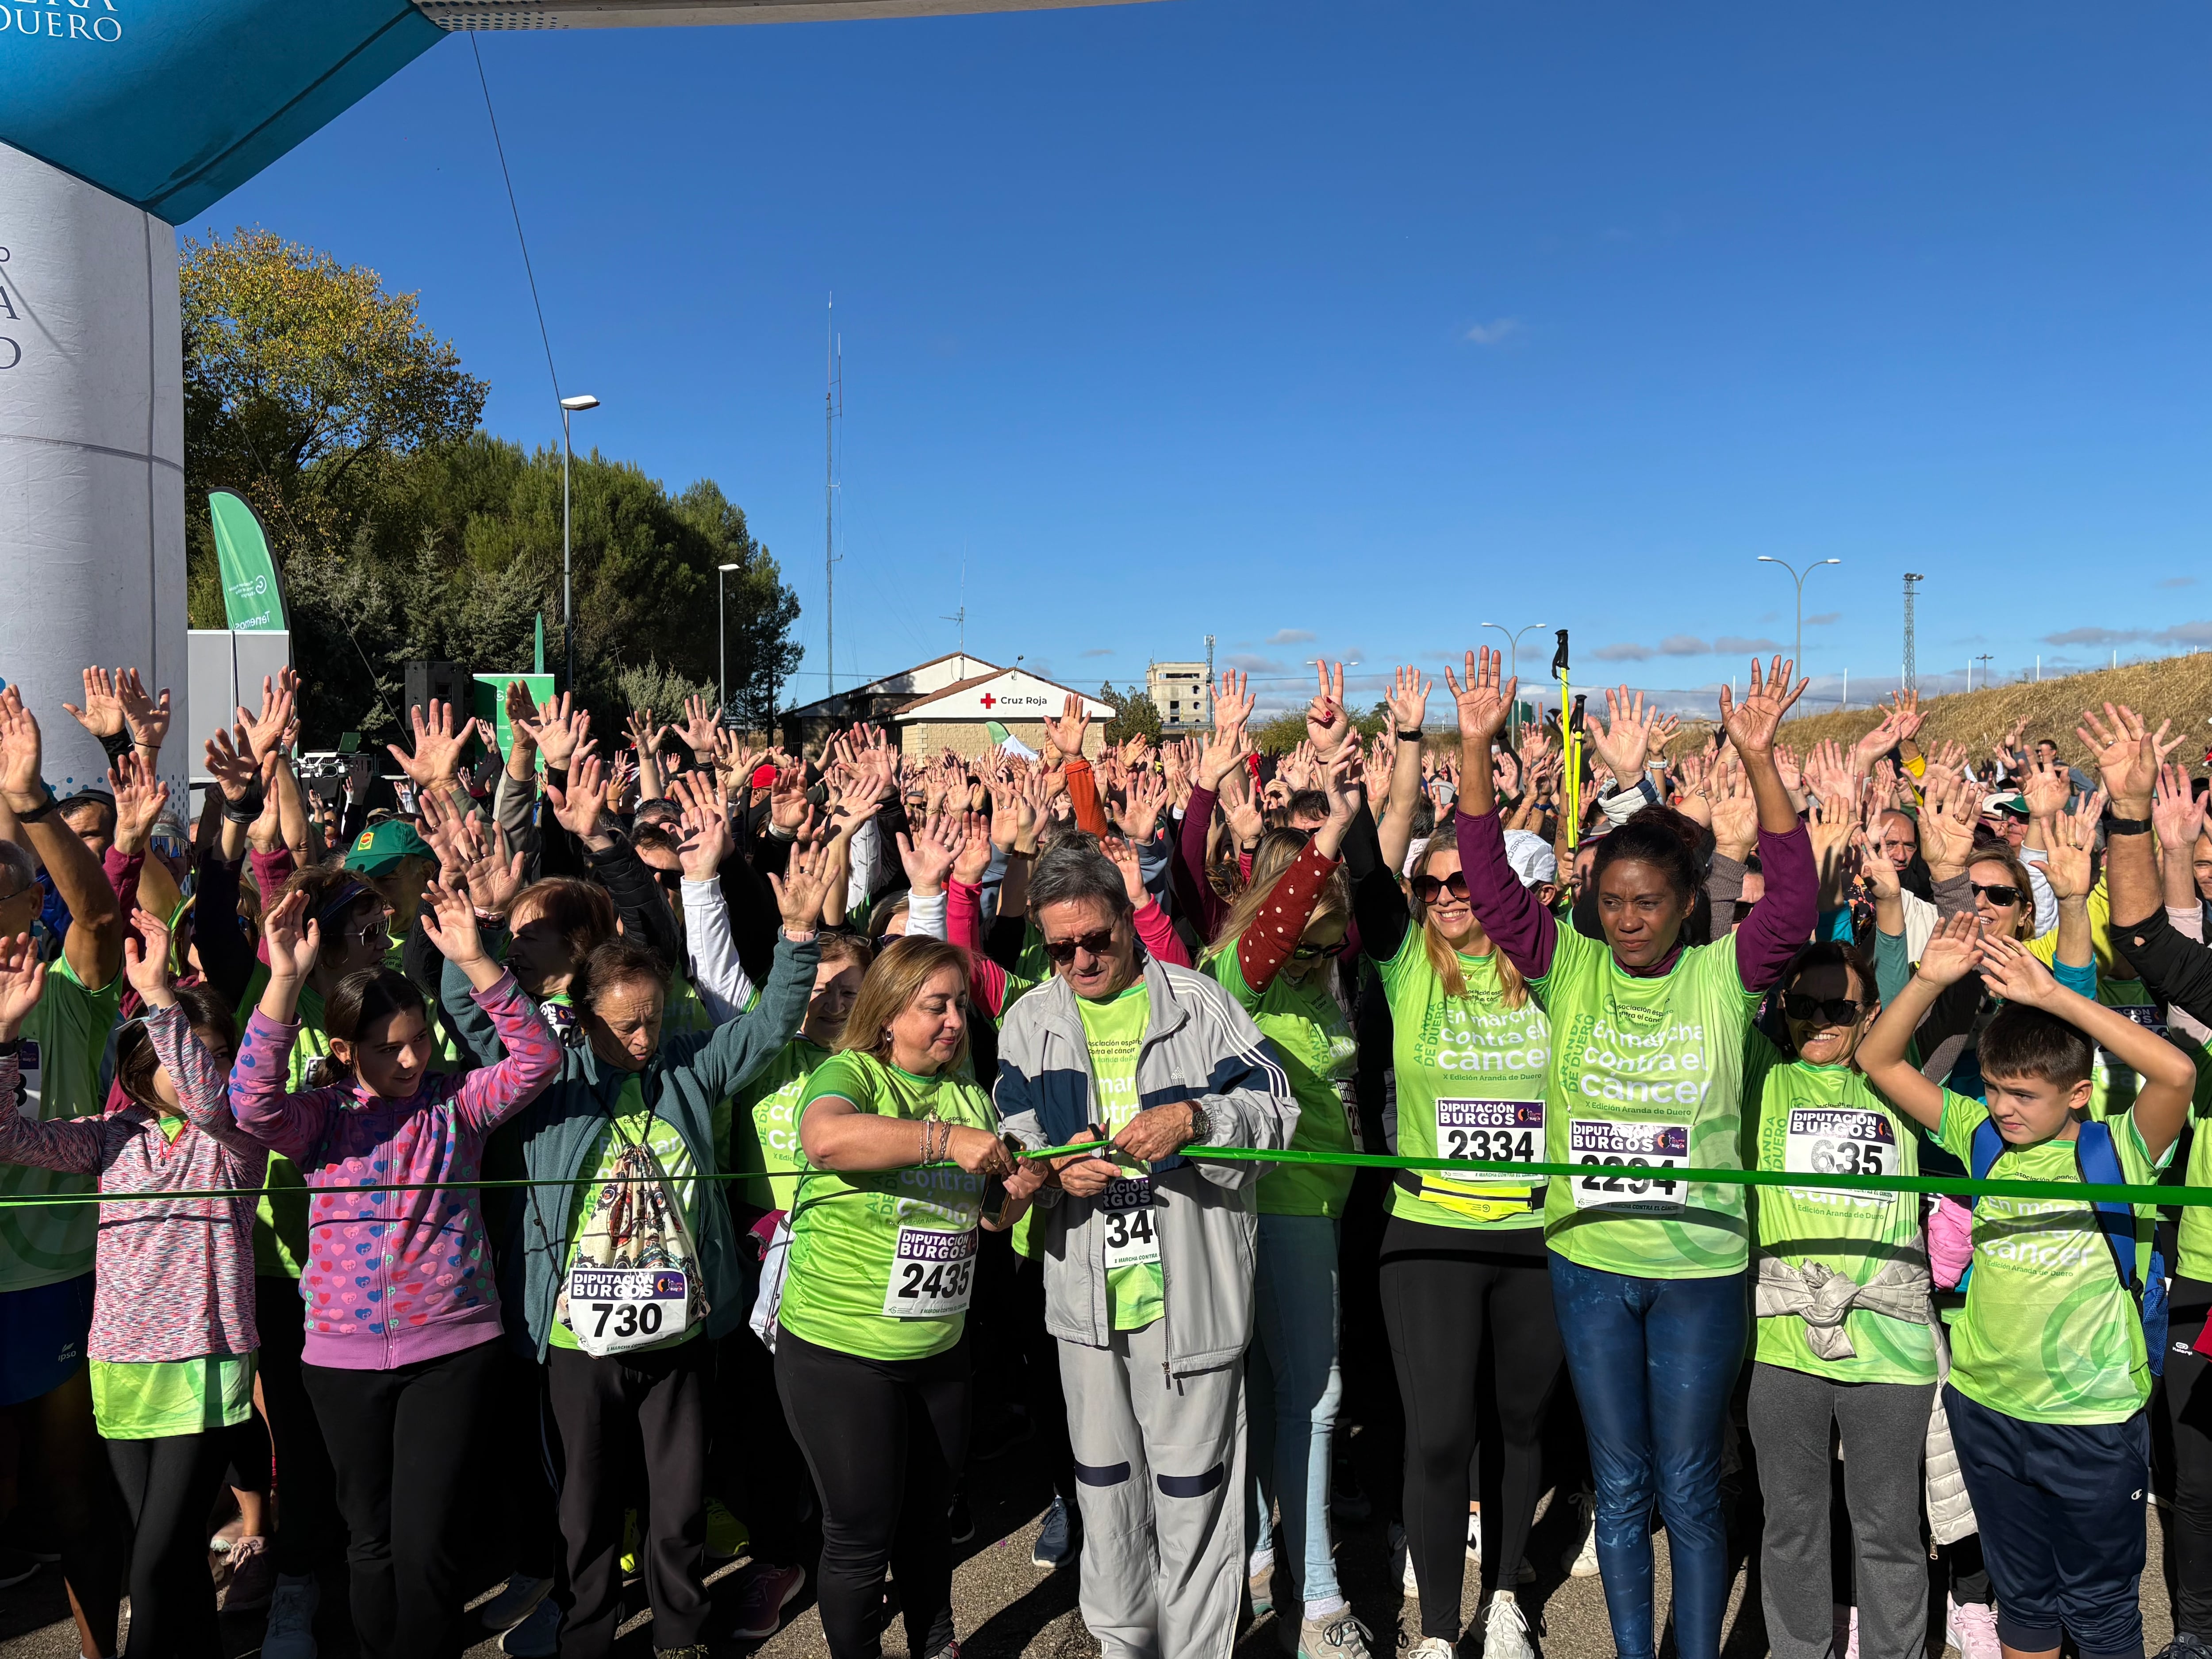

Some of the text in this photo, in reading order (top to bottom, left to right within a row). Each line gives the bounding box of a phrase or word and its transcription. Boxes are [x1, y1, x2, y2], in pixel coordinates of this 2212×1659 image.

[1026, 696, 1047, 706] Roja
[1471, 1002, 1540, 1028] marcha
[1617, 1005, 1651, 1014] sociación
[1413, 1003, 1436, 1065] ARANDA
[1424, 1001, 1444, 1067] DE DUERO
[1440, 1018, 1548, 1047] contra el
[1593, 1019, 1703, 1048] En marcha
[1559, 1013, 1584, 1088] ARANDA
[1568, 1015, 1595, 1093] DE DUERO
[1584, 1046, 1709, 1072] contra el
[1581, 1071, 1712, 1104] cáncer
[1440, 1102, 1514, 1113] DIPUTACIÓN
[1592, 1102, 1620, 1112] Edición
[1622, 1106, 1652, 1114] Aranda
[1440, 1113, 1515, 1125] BURGOS
[1793, 1112, 1877, 1126] DIPUTACIÓN
[759, 1126, 768, 1145] DE
[1573, 1125, 1654, 1139] DIPUTACIÓN
[1792, 1121, 1877, 1139] BURGOS
[1448, 1130, 1534, 1162] 2334
[1573, 1135, 1654, 1152] BURGOS
[1772, 1118, 1788, 1170] DUERO
[1811, 1140, 1882, 1176] 635
[901, 1168, 976, 1192] contra
[1581, 1155, 1676, 1195] 2294
[880, 1195, 895, 1215] DE
[1103, 1190, 1150, 1207] RGOS
[1798, 1205, 1824, 1216] Edición
[1826, 1209, 1852, 1218] Aranda
[1106, 1210, 1158, 1248] 34
[902, 1233, 969, 1246] DIPUTACIÓN
[900, 1243, 966, 1259] BURGOS
[1987, 1260, 2010, 1271] Edición
[2012, 1265, 2037, 1275] Aranda
[574, 1273, 654, 1284] DIPUTACIÓN
[898, 1260, 972, 1298] 2435
[573, 1284, 654, 1298] BURGOS
[592, 1303, 662, 1337] 730
